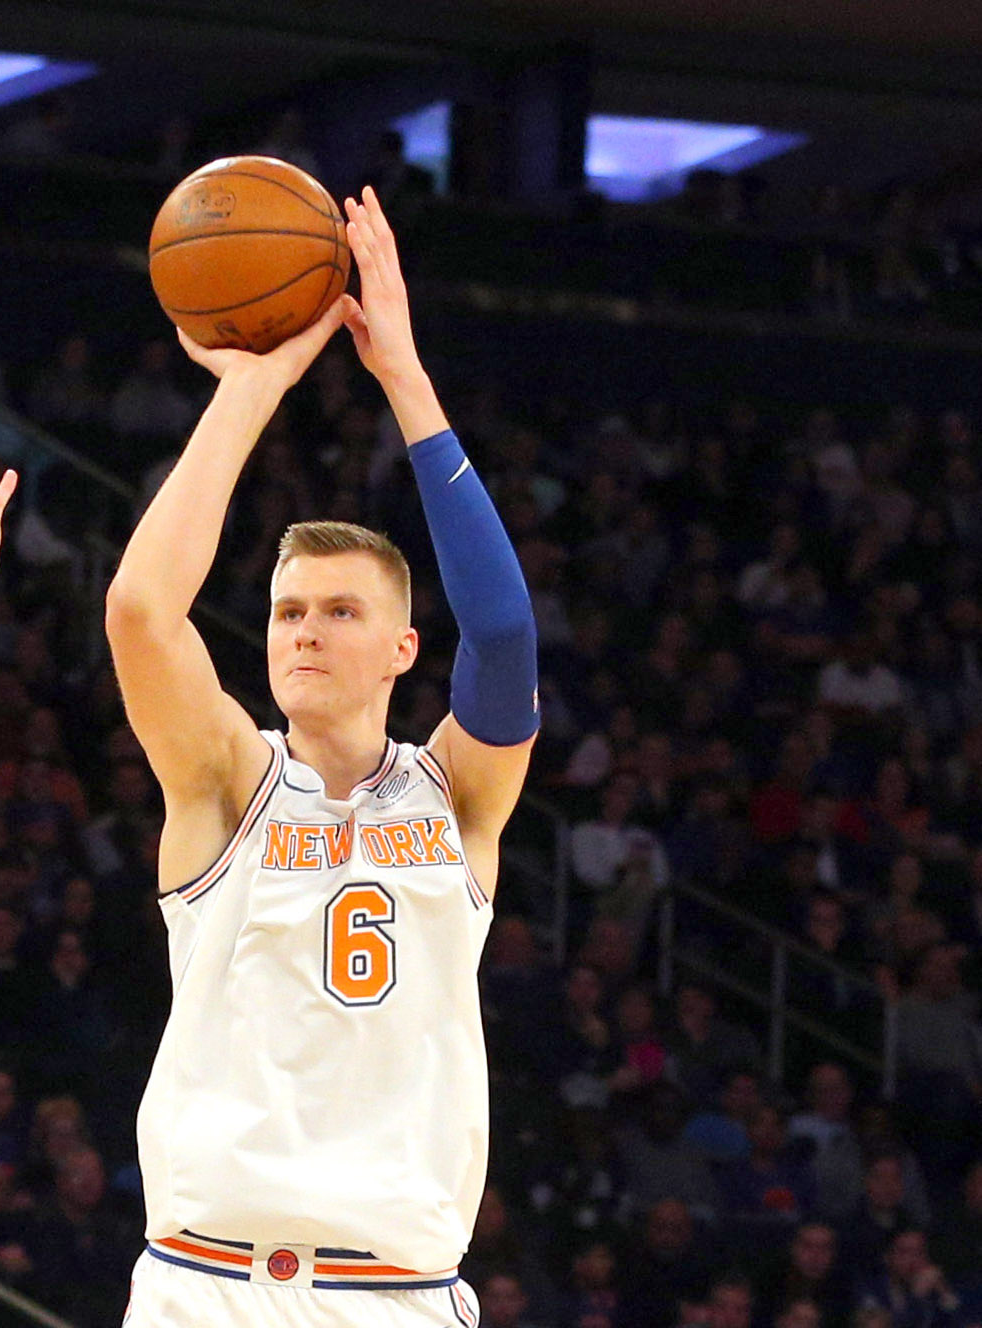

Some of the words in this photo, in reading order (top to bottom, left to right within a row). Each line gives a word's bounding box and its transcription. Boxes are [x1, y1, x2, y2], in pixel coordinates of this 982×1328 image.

[262, 810, 356, 870] NEW
[358, 816, 463, 869] ORK
[324, 882, 396, 1008] 6
